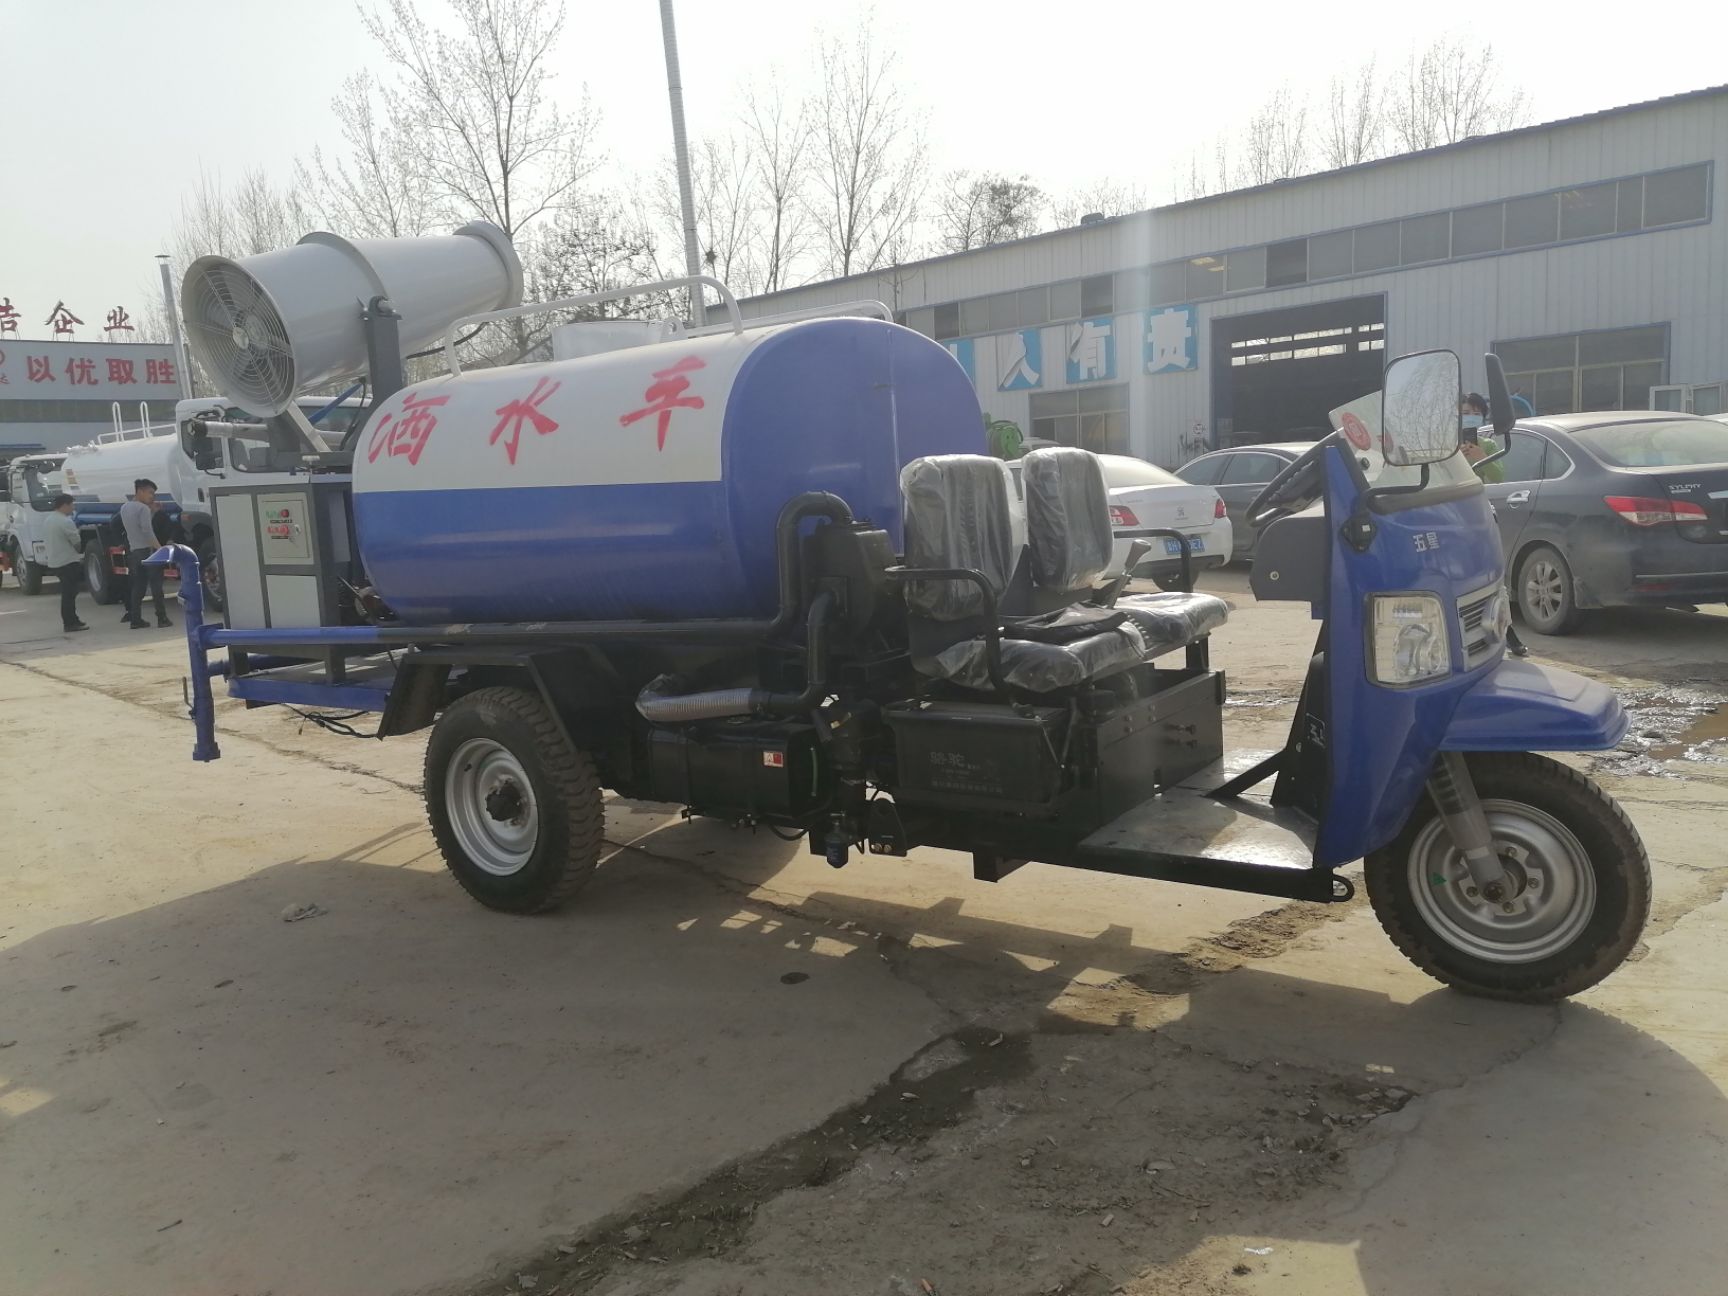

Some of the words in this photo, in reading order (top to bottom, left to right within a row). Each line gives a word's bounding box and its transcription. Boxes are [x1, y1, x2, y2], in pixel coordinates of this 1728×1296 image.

[26, 355, 177, 385] 以优取胜
[950, 308, 1192, 388] 人有责
[368, 355, 706, 466] 洒水车
[1412, 531, 1440, 553] 五星
